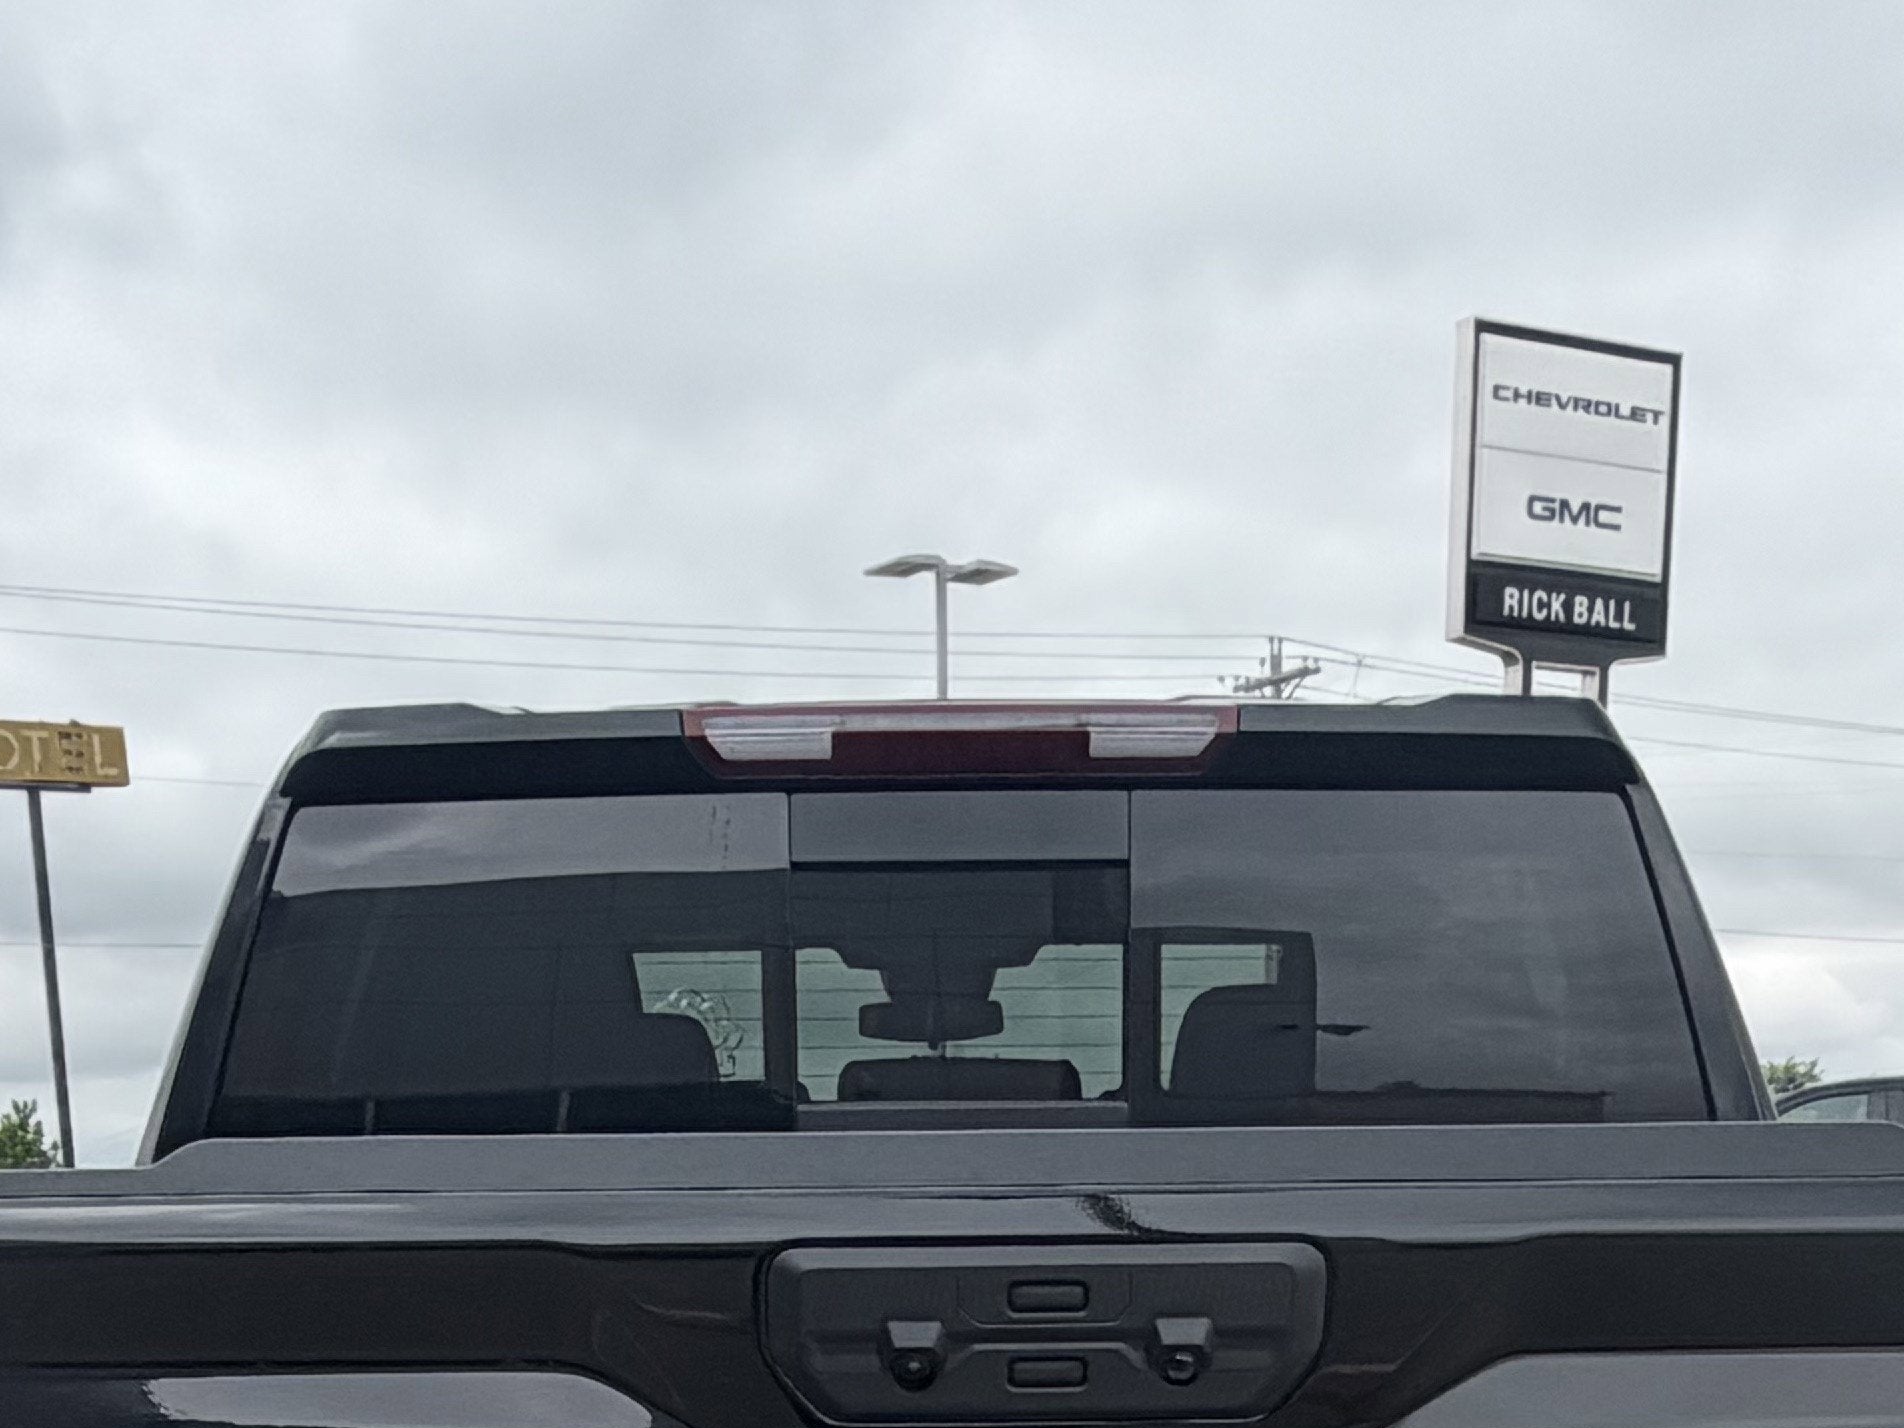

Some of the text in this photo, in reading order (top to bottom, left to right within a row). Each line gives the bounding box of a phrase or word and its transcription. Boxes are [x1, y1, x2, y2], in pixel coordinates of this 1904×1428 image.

[1492, 384, 1665, 426] CHEVROLET
[1526, 494, 1623, 532] GMC
[1503, 586, 1636, 631] RICK BALL
